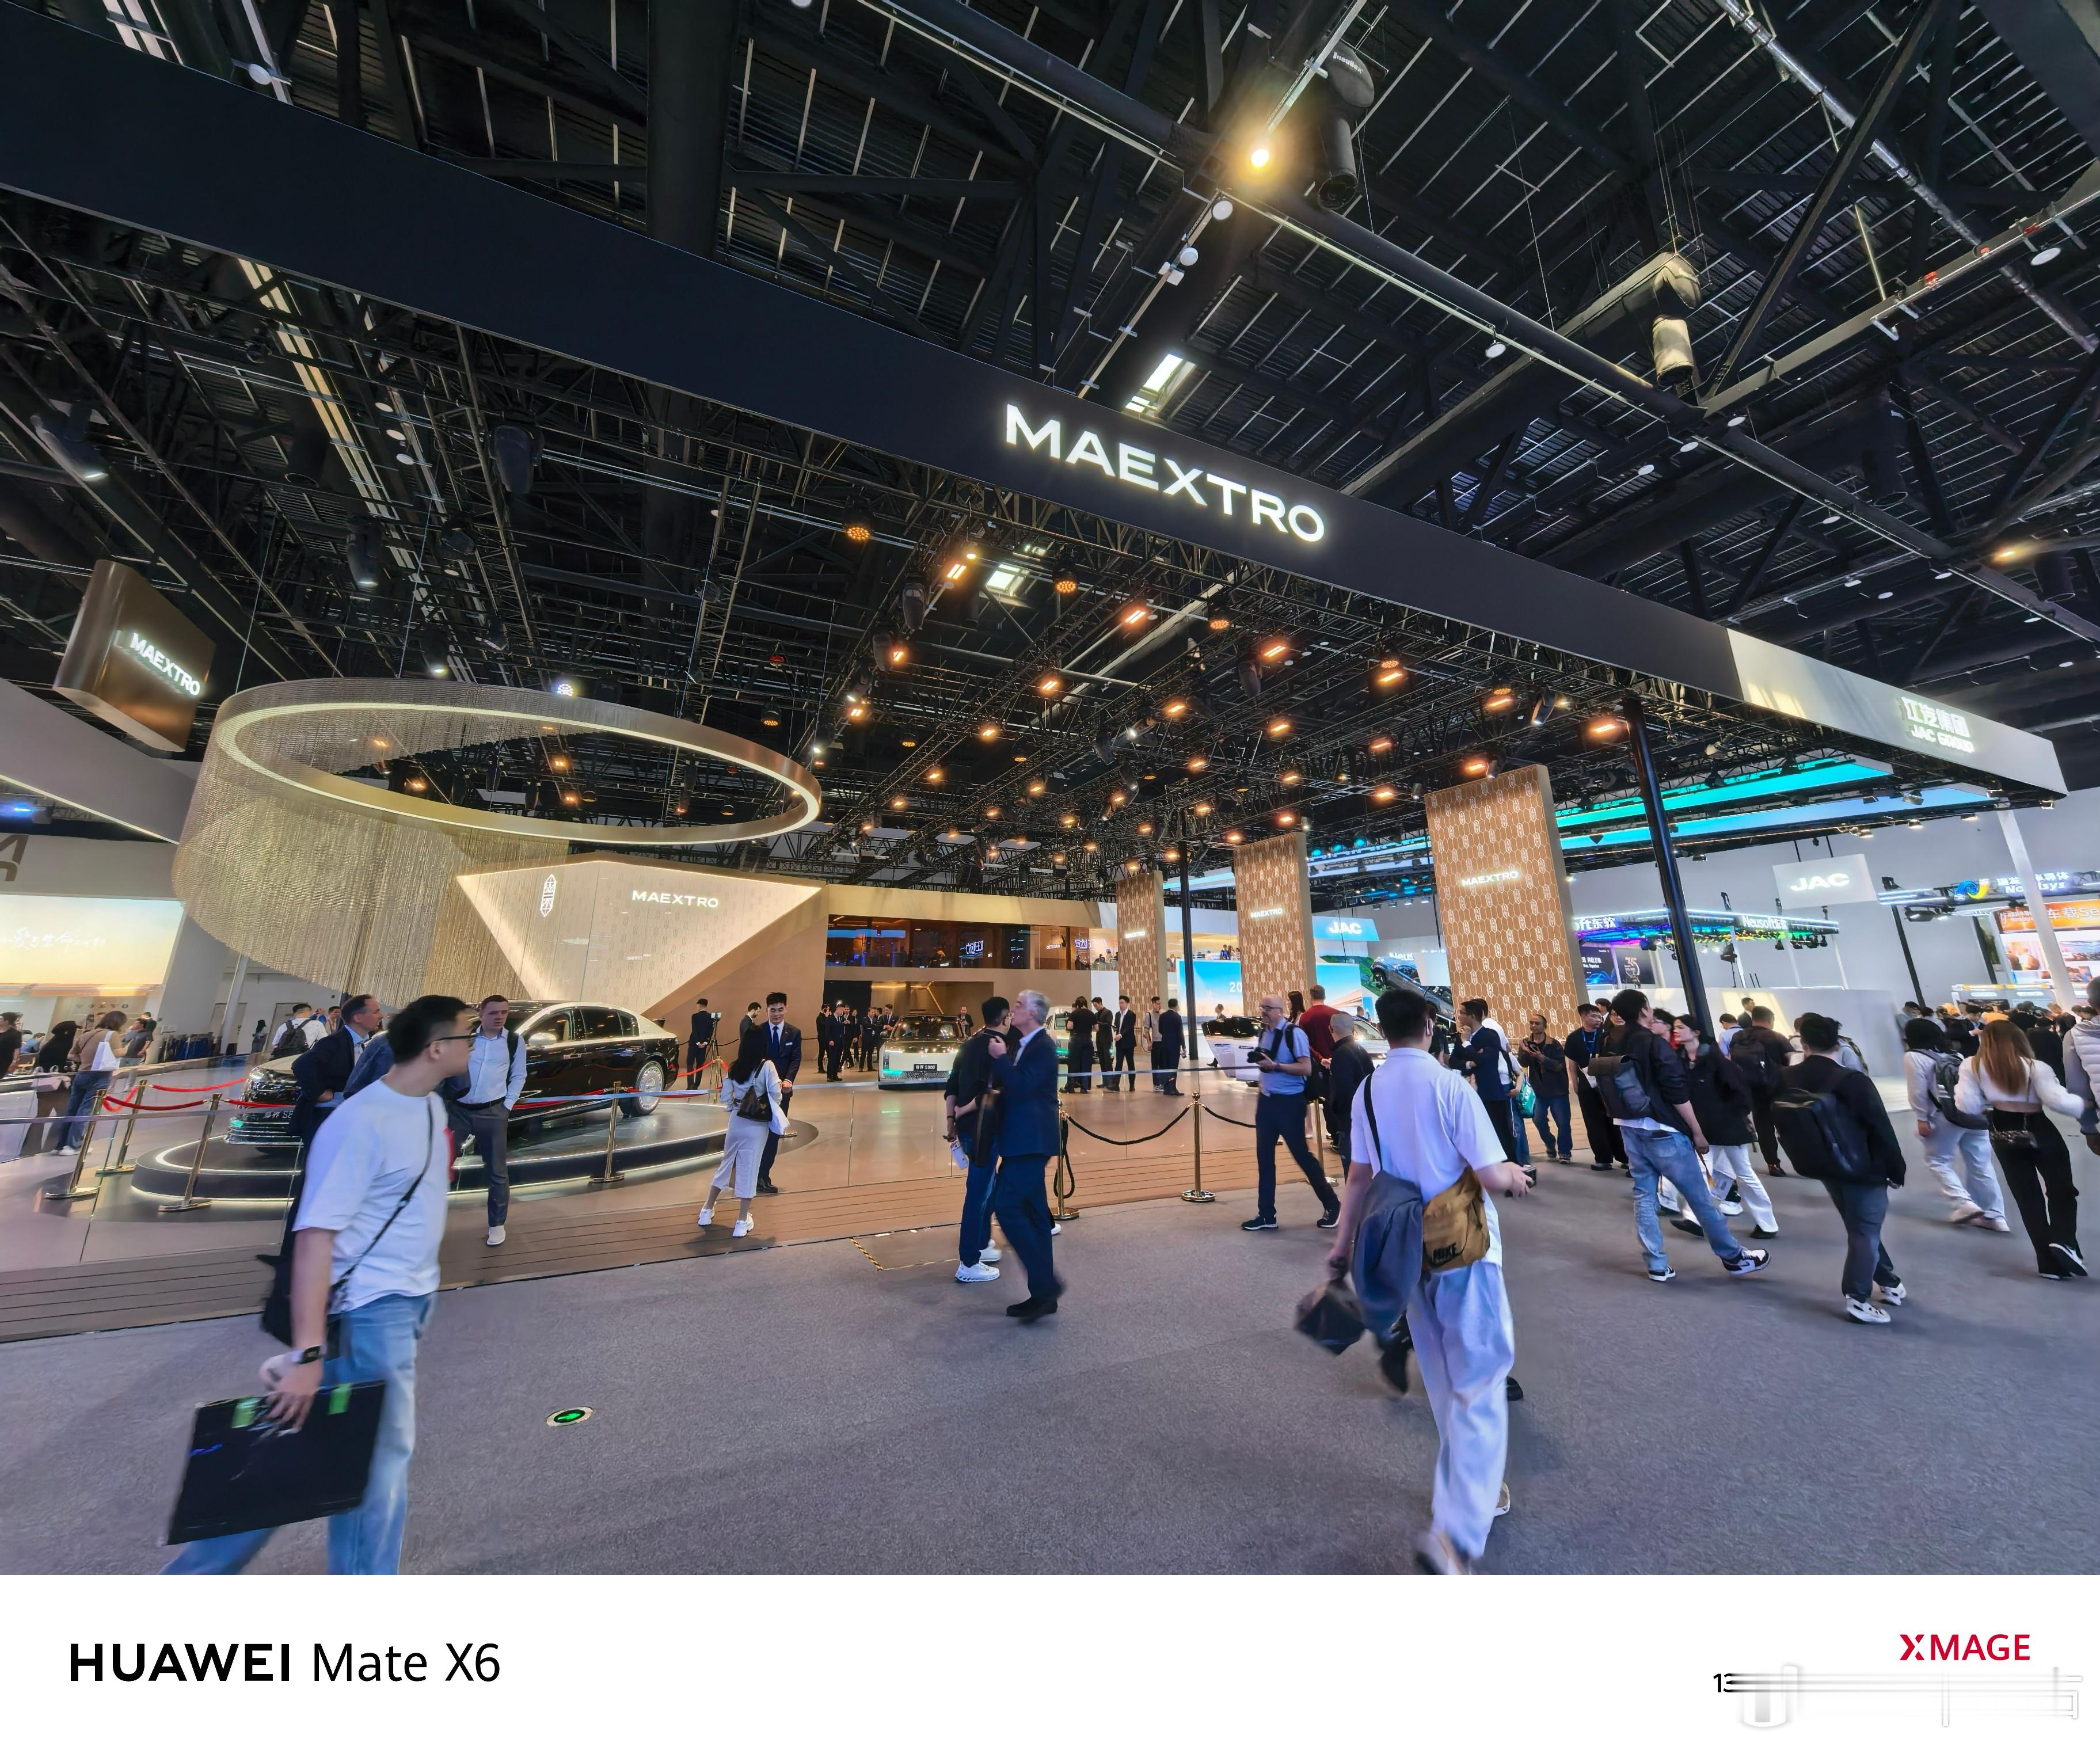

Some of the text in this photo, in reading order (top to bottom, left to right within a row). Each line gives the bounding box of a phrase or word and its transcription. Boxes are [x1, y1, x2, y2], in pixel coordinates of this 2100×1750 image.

[1006, 404, 1325, 542] MAEXTRO
[130, 633, 200, 695] MAEXTRO
[1911, 724, 1975, 753] JAC GROUP
[1462, 871, 1519, 887] MAEXTRO
[1790, 873, 1850, 891] JAC
[2005, 881, 2065, 893] Nolsys
[632, 890, 719, 908] MAEXTRO
[1250, 908, 1283, 918] MAEXTRO
[1329, 921, 1363, 935] JAC
